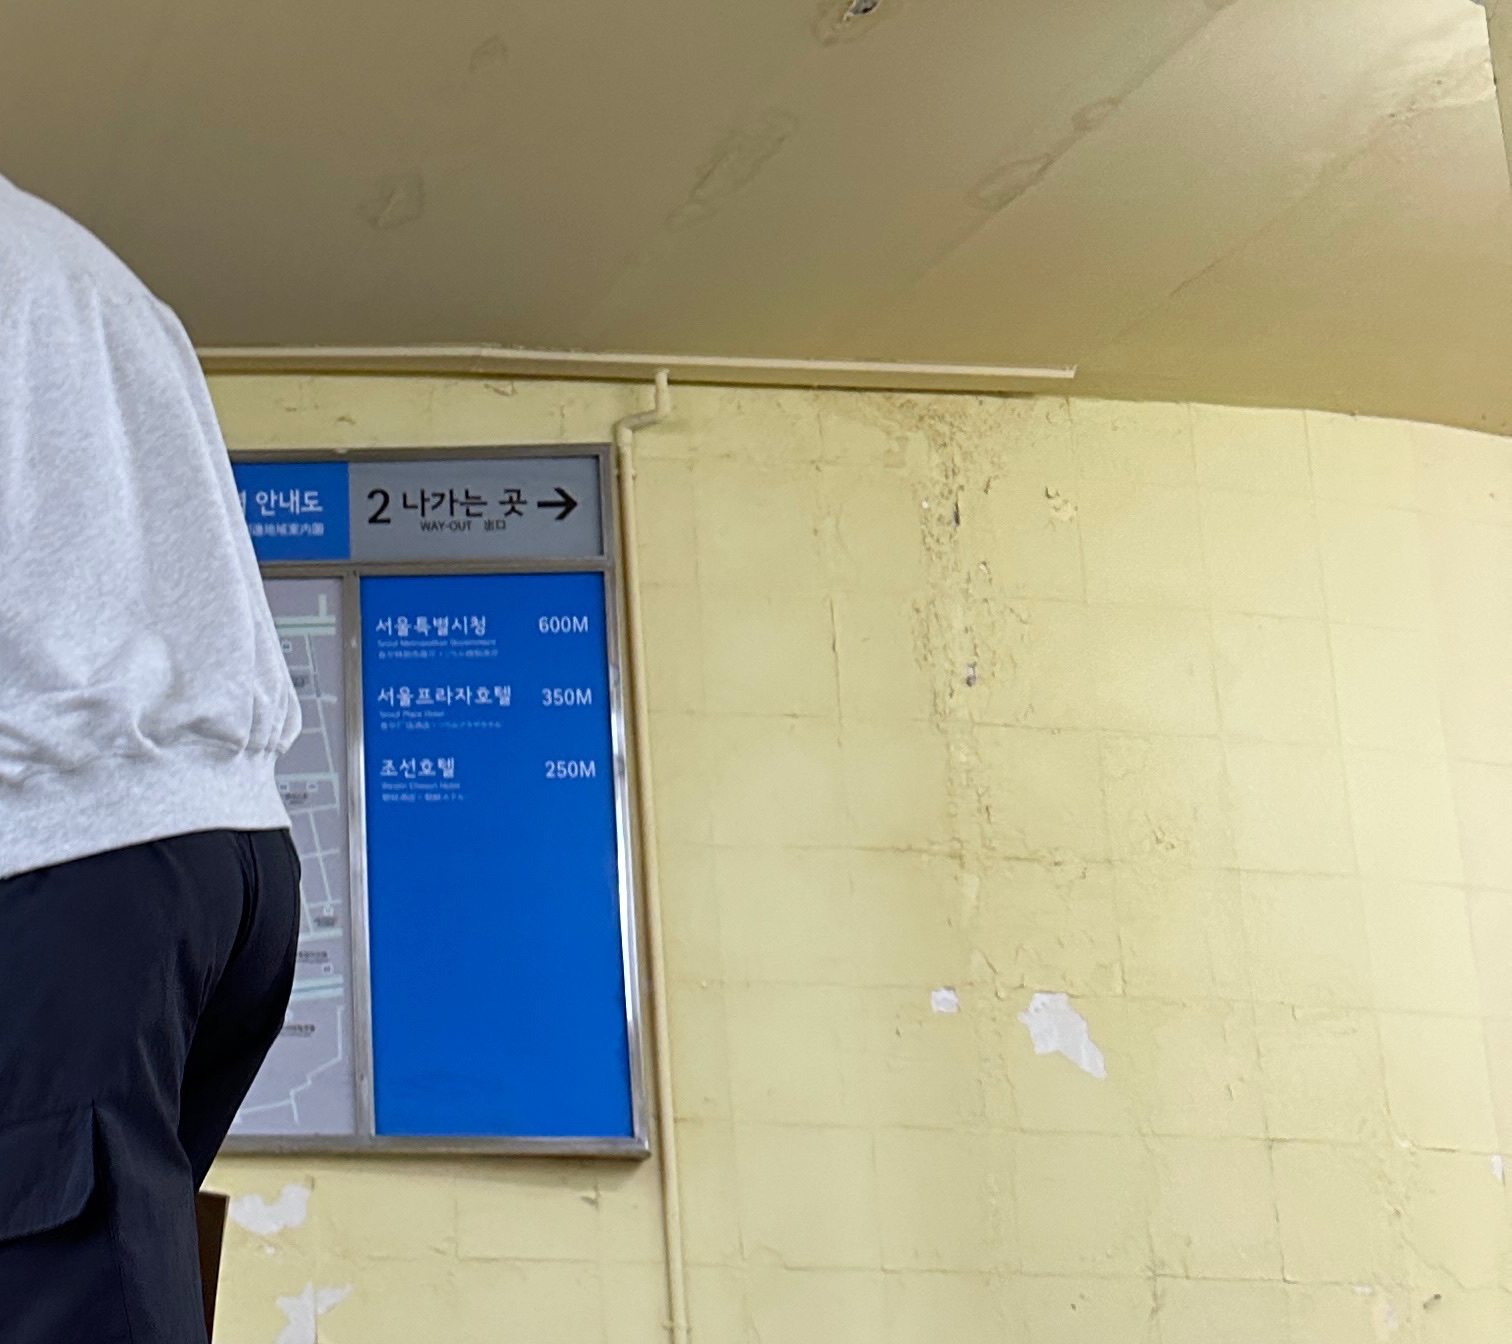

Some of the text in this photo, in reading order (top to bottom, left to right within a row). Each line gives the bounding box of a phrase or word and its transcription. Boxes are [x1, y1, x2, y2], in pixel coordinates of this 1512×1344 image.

[256, 489, 324, 517] 안내도
[367, 488, 528, 524] 2 나가는 곳
[420, 520, 473, 531] WAY-OUT
[375, 615, 589, 637] 서울특별시청 600M
[377, 685, 593, 707] 서울프라자호텔 350M
[380, 757, 596, 779] 조선호텔 250M
